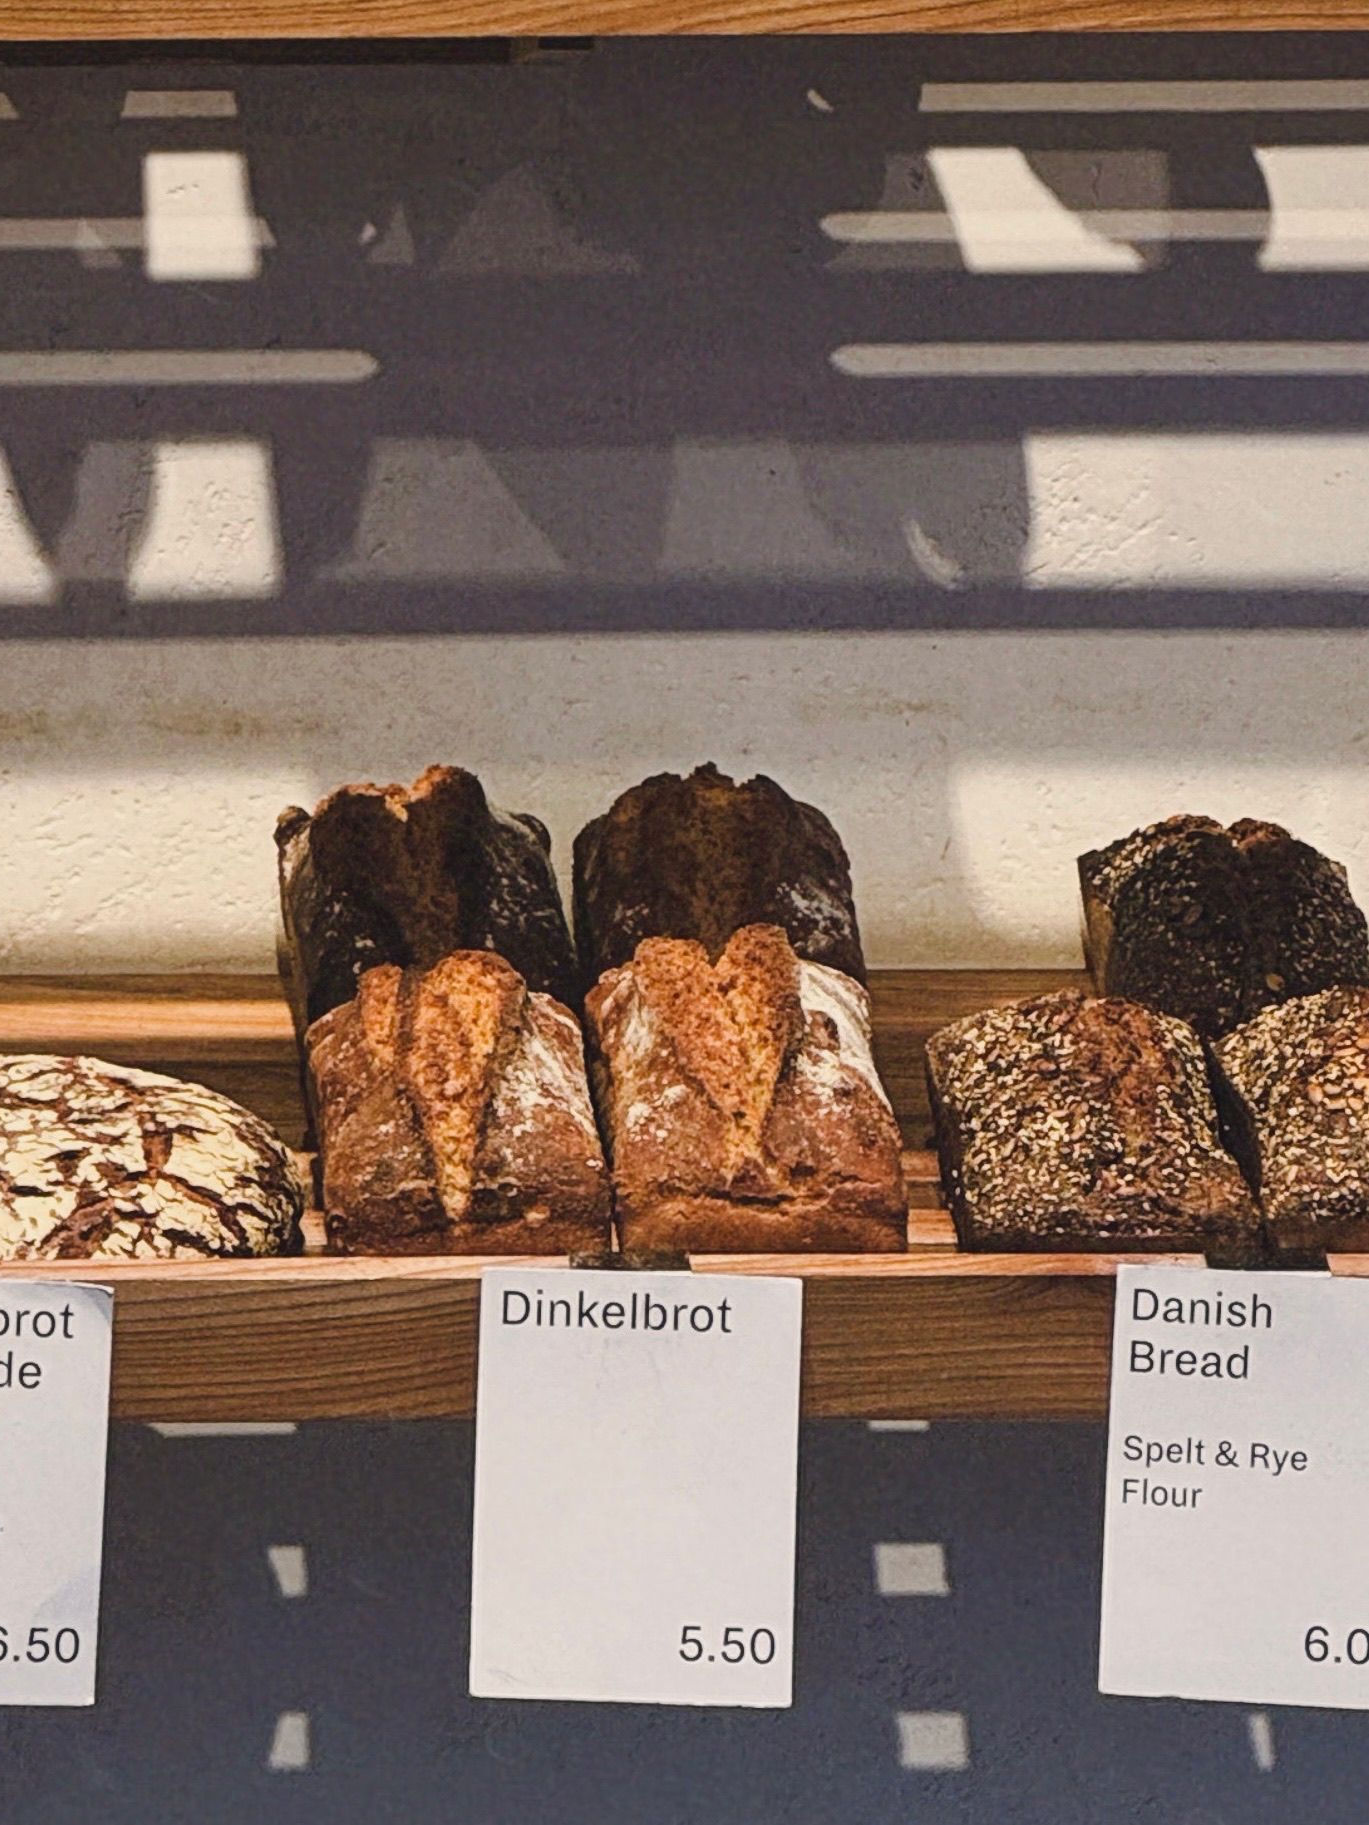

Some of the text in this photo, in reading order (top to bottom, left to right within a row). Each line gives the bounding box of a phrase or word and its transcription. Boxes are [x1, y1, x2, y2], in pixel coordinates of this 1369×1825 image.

[502, 1289, 732, 1333] Dinkelbrot
[1132, 1288, 1272, 1328] Danish
[1129, 1340, 1249, 1379] Bread
[1123, 1435, 1308, 1476] Spelt & Rye
[1122, 1478, 1203, 1508] Flour
[679, 1625, 776, 1665] 5.50
